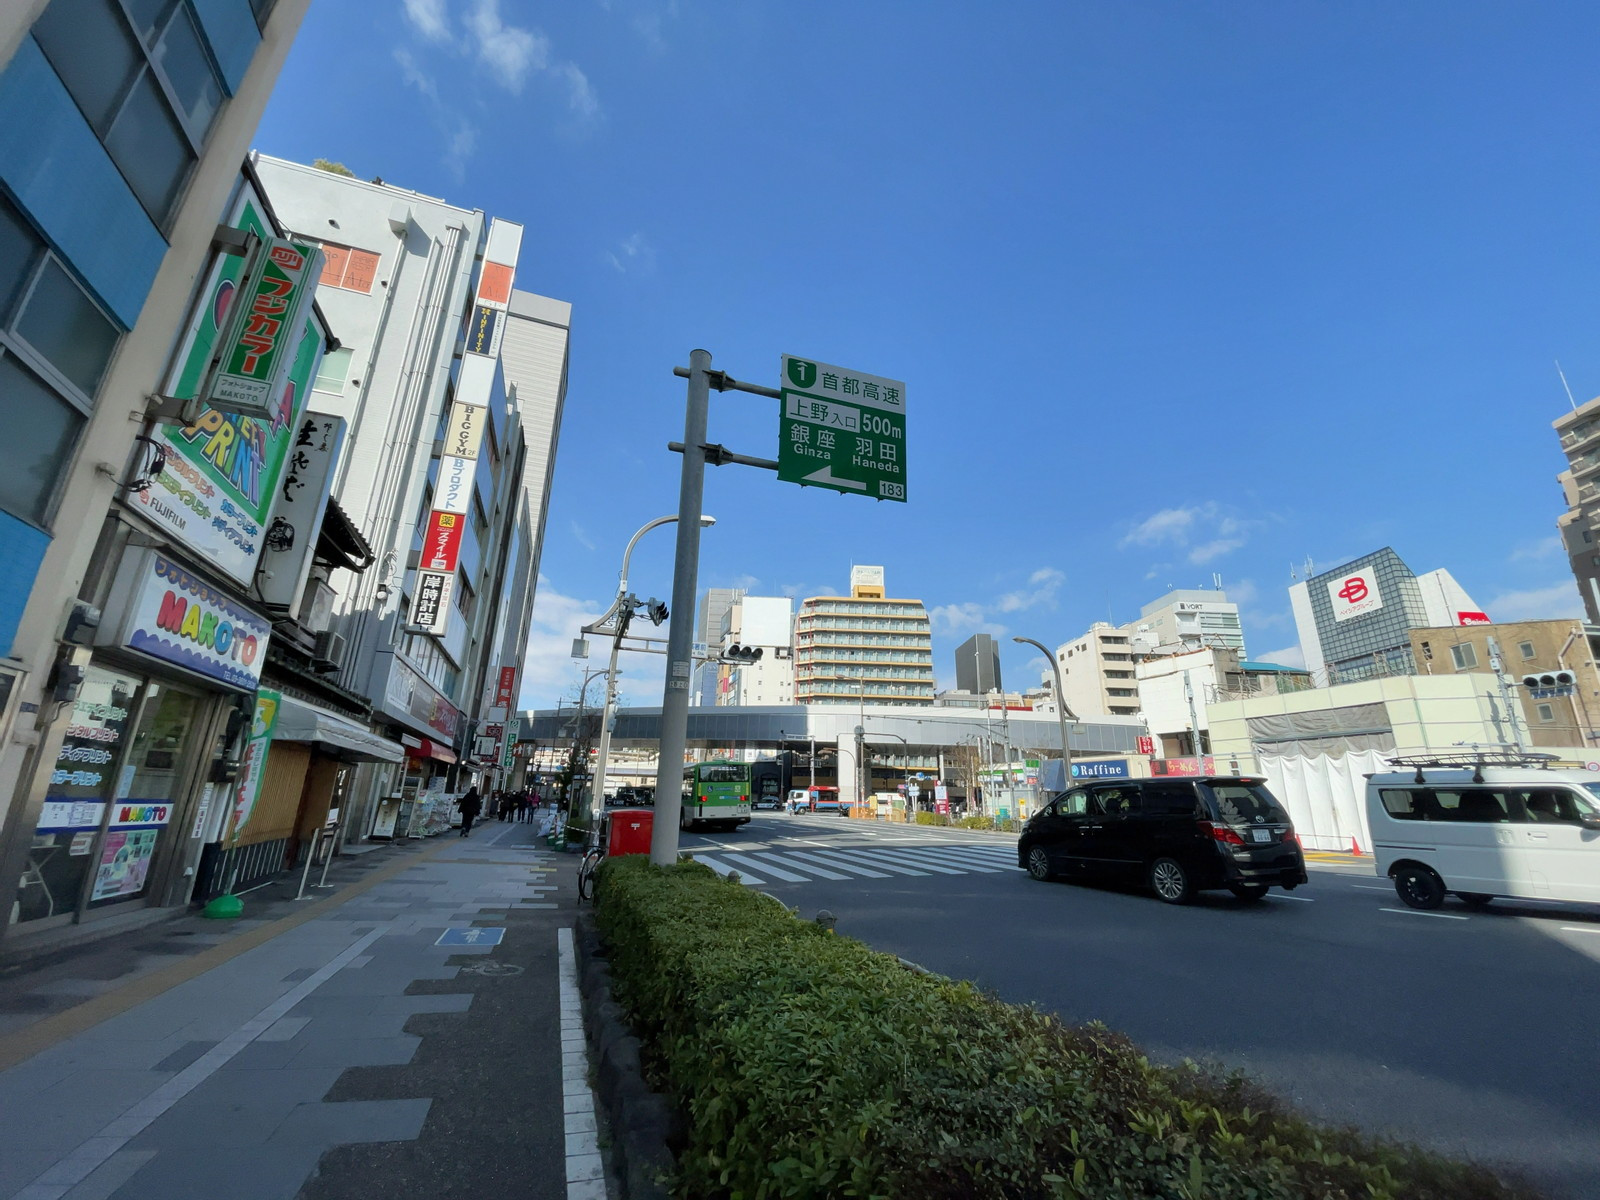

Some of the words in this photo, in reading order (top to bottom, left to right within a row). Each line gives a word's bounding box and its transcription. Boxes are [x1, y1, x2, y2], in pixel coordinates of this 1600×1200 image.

[240, 275, 294, 375] フジカラー
[219, 389, 259, 402] MAKOTO
[220, 379, 266, 393] フォトショップ
[821, 372, 901, 406] 首都高速
[790, 423, 836, 450] 銀座
[862, 413, 902, 440] 500m
[180, 408, 260, 510] PRINT
[793, 443, 832, 461] Ginza
[855, 436, 897, 462] 羽田
[852, 454, 901, 474] Haneda
[880, 482, 904, 498] 183
[150, 497, 187, 531] FUJIFILM
[441, 514, 454, 526] 薬
[434, 532, 450, 559] スマイル
[416, 575, 441, 625] 岸時計店
[156, 589, 258, 667] MAKOTO
[1080, 764, 1122, 776] Raffine
[119, 806, 168, 823] MAKOTO
